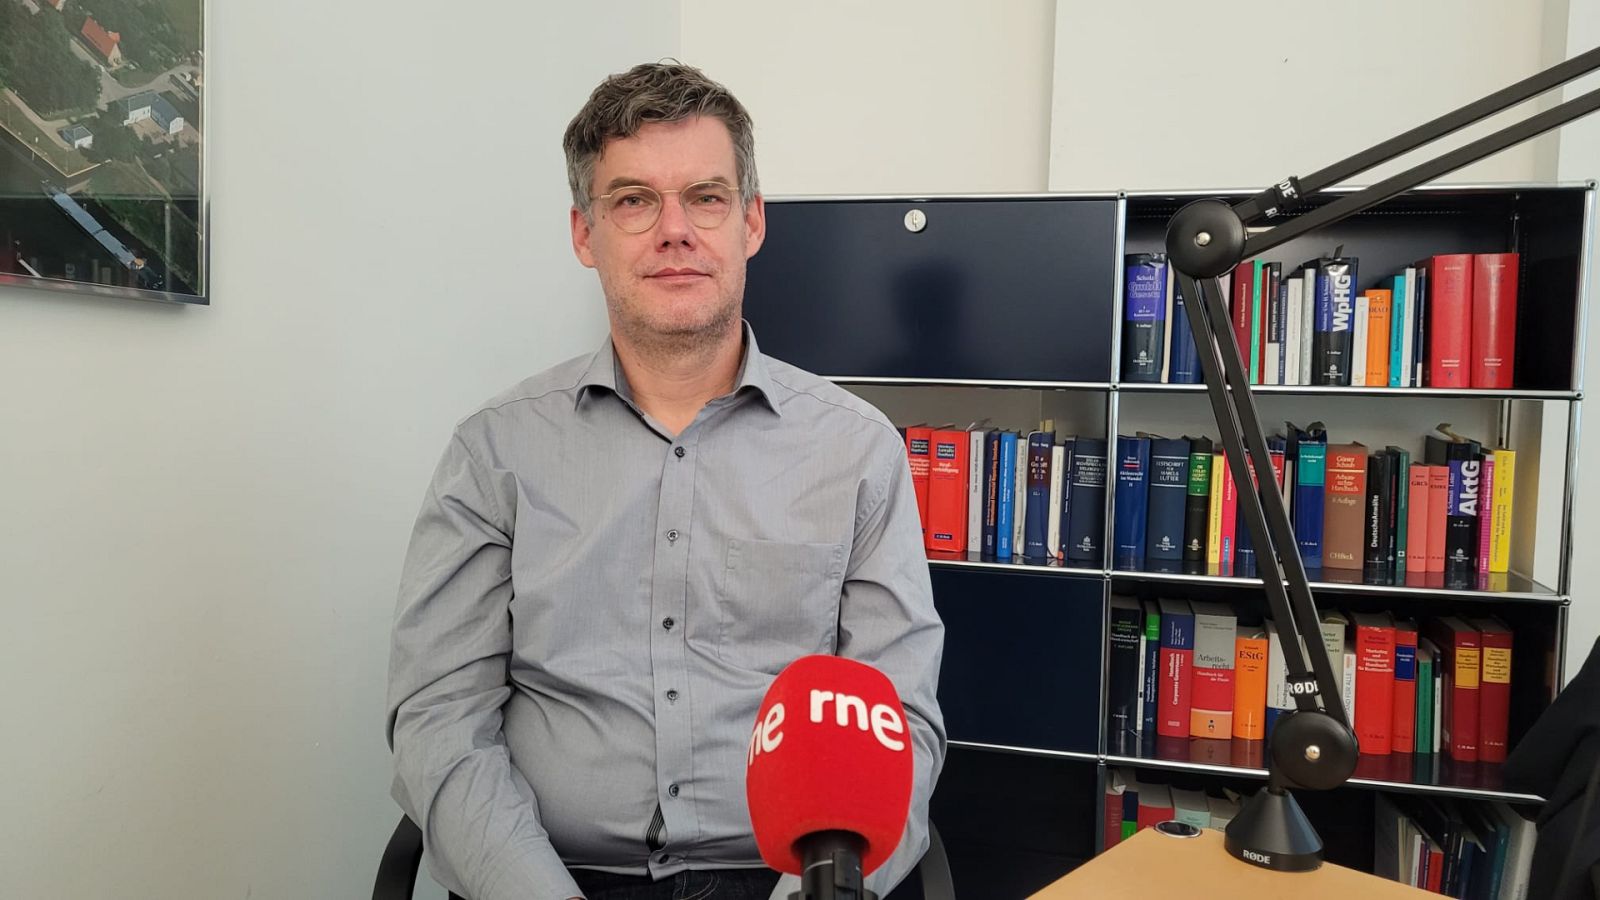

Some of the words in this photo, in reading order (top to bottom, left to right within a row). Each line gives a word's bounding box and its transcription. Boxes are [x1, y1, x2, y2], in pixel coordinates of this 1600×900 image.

[1332, 275, 1352, 332] WpHG
[1459, 460, 1480, 516] AktG
[1370, 494, 1379, 548] DeutscheAnwälte
[1239, 650, 1263, 660] EStG
[809, 688, 905, 752] rne
[1172, 681, 1180, 705] Corporate
[1243, 849, 1271, 866] RØDE
